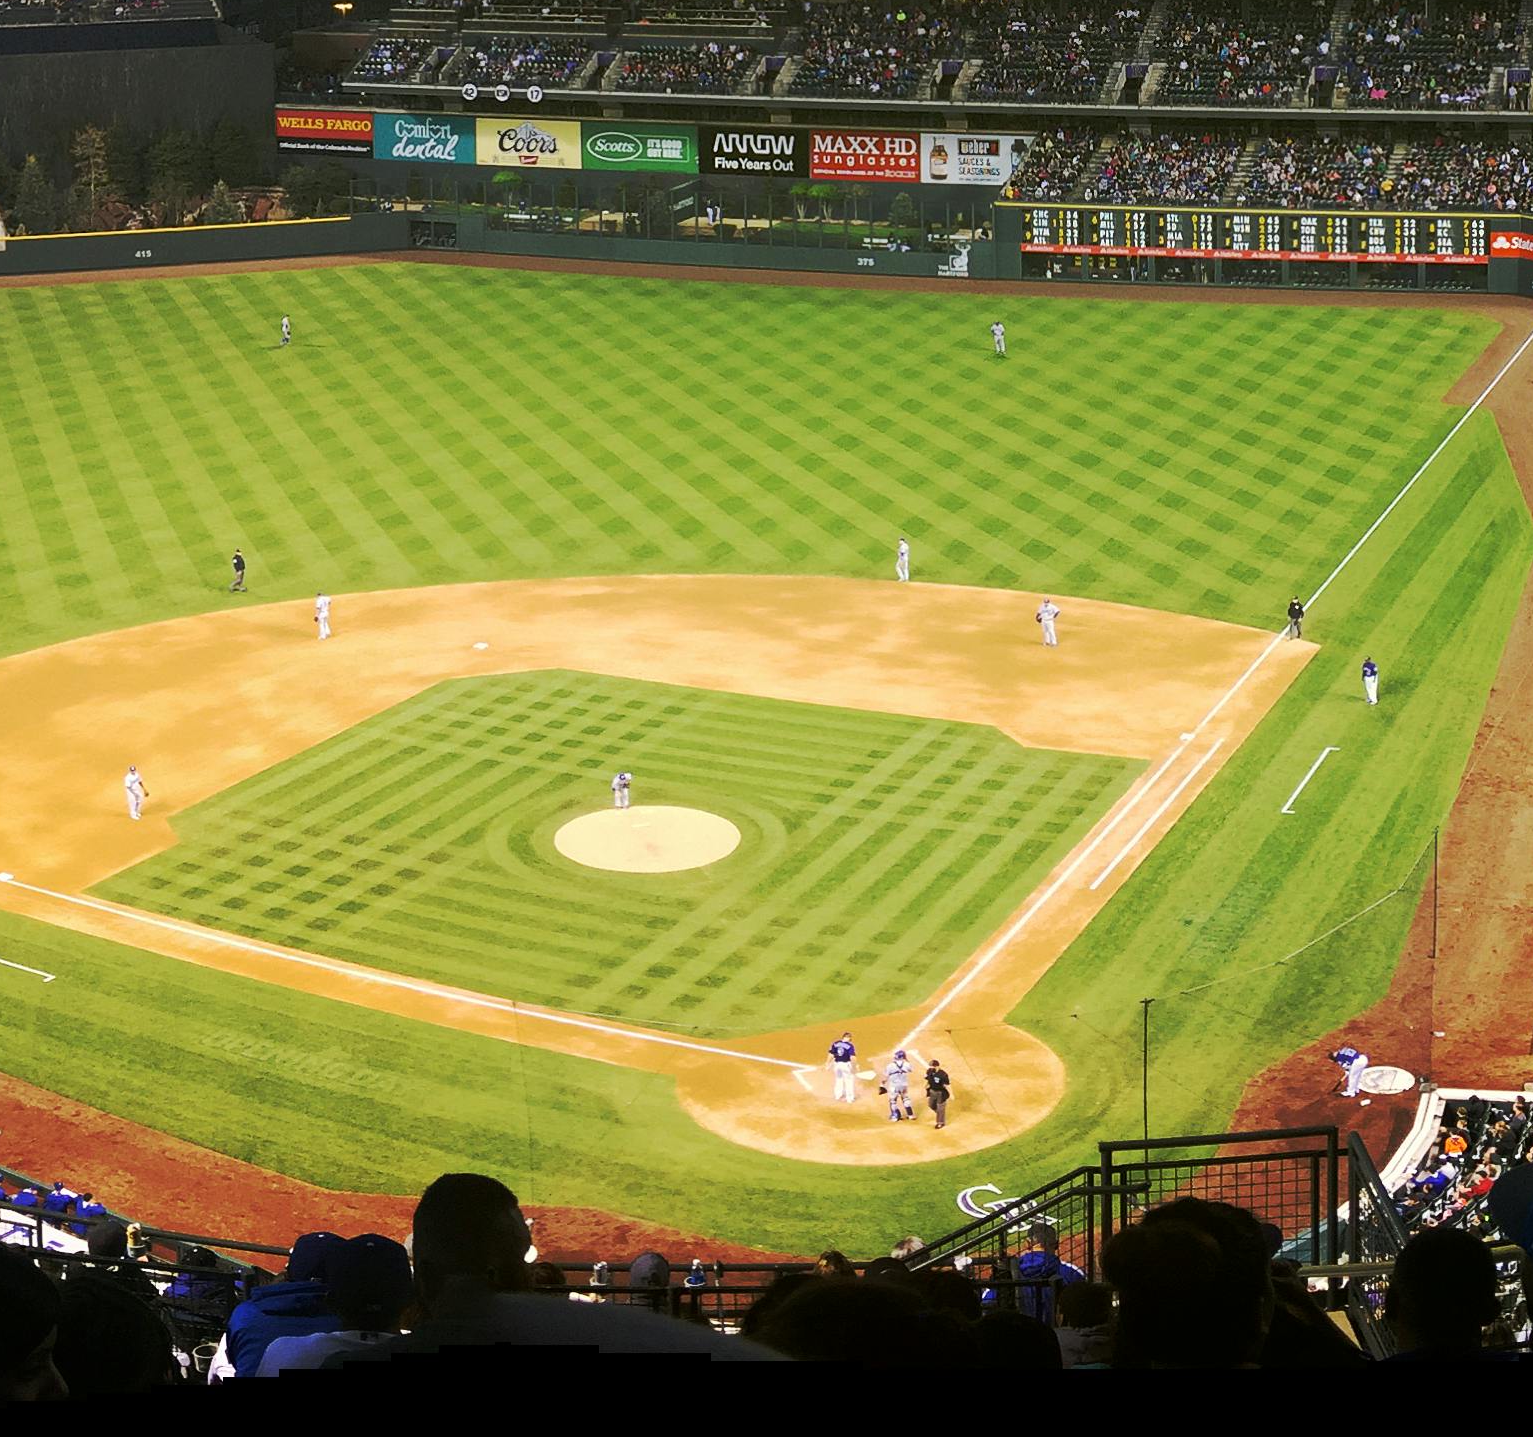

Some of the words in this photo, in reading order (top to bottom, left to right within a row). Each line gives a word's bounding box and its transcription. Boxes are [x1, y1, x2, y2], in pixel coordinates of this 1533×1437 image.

[278, 117, 324, 130] WELLS
[326, 119, 371, 132] FARGO
[395, 118, 452, 138] Comfort
[392, 135, 455, 161] dental
[497, 128, 558, 153] Coors
[594, 139, 635, 154] Scotts
[813, 135, 881, 154] MAXX
[958, 139, 991, 155] weber
[715, 157, 738, 169] Five
[739, 157, 771, 170] Years
[773, 159, 794, 171] Out
[813, 154, 916, 167] sunglasses
[958, 157, 983, 167] SAUCES
[958, 166, 1000, 176] SEASONINGS
[135, 249, 152, 258] 415
